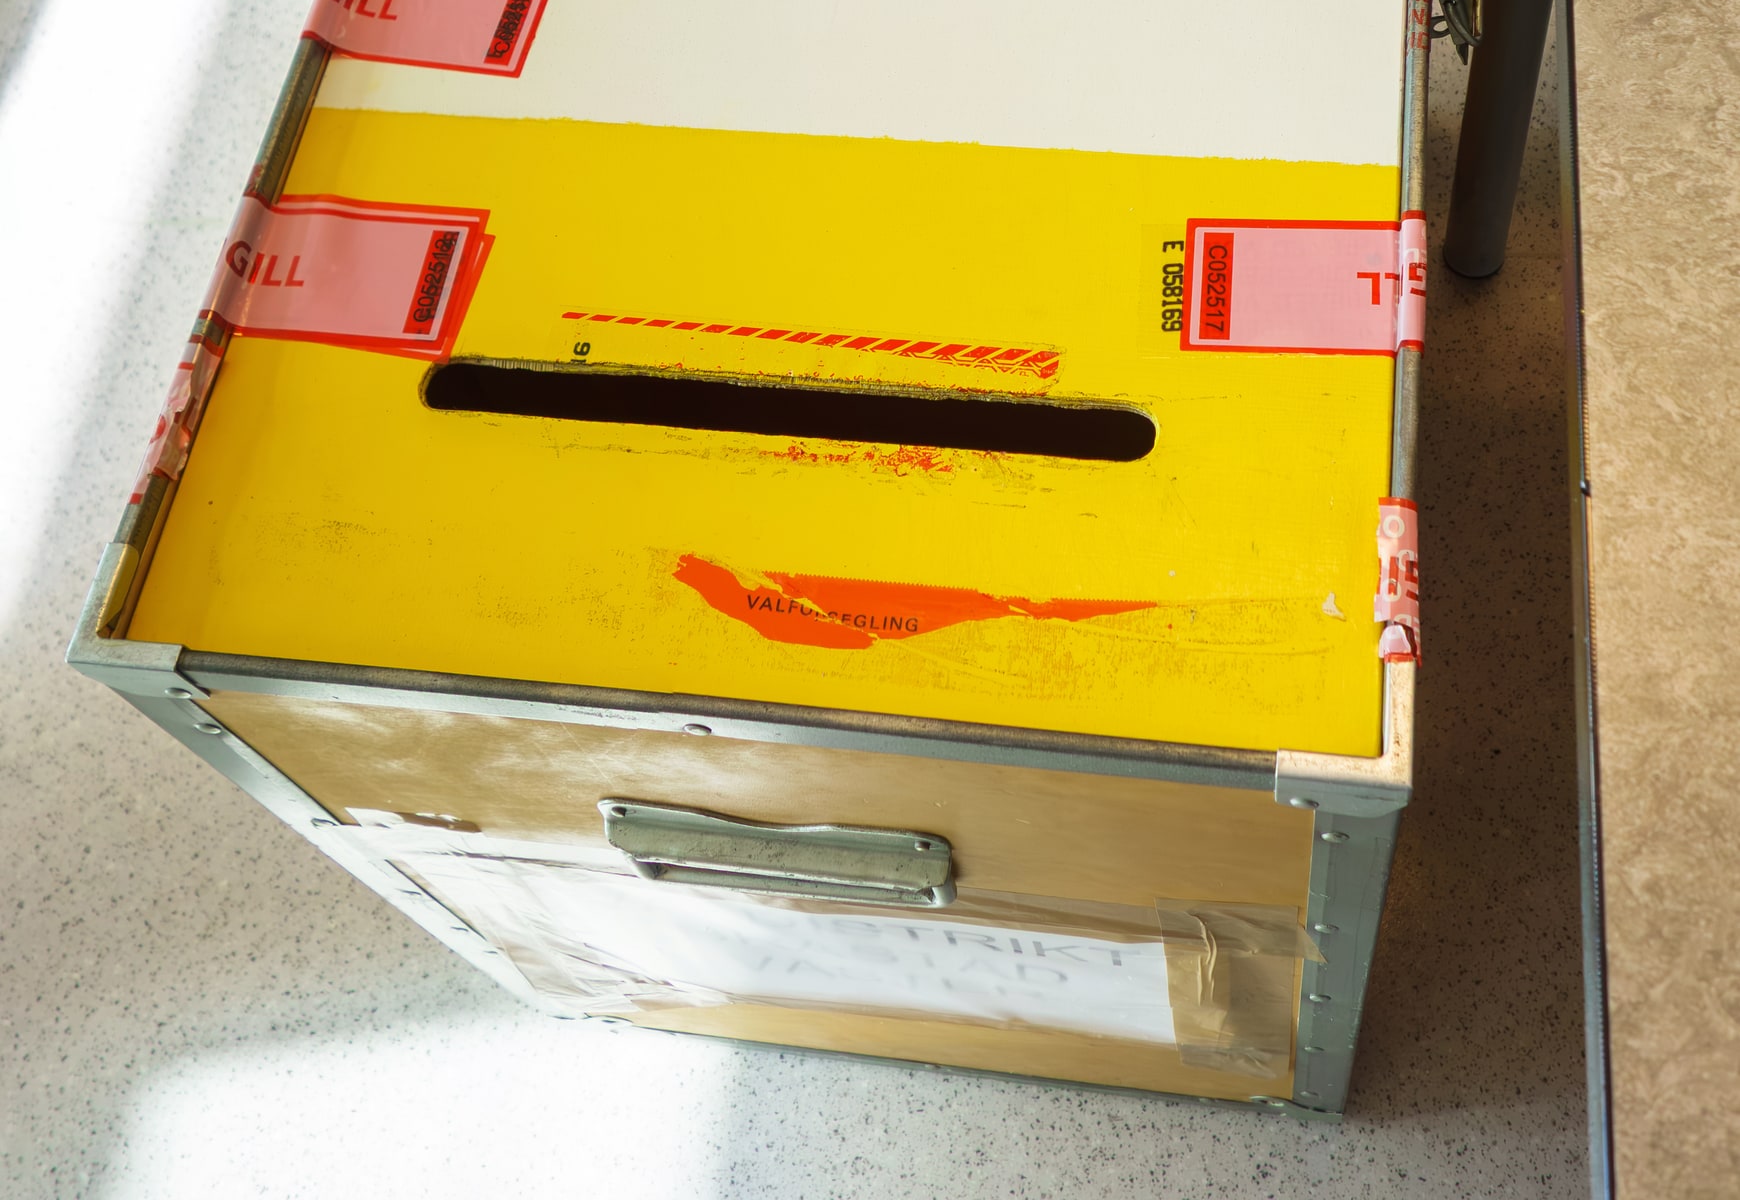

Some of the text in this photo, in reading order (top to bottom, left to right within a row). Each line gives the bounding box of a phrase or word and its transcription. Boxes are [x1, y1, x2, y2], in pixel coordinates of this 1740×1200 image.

[1161, 240, 1184, 333] E 058169
[1206, 245, 1228, 332] C052517
[747, 594, 919, 633] VALFSEGLING
